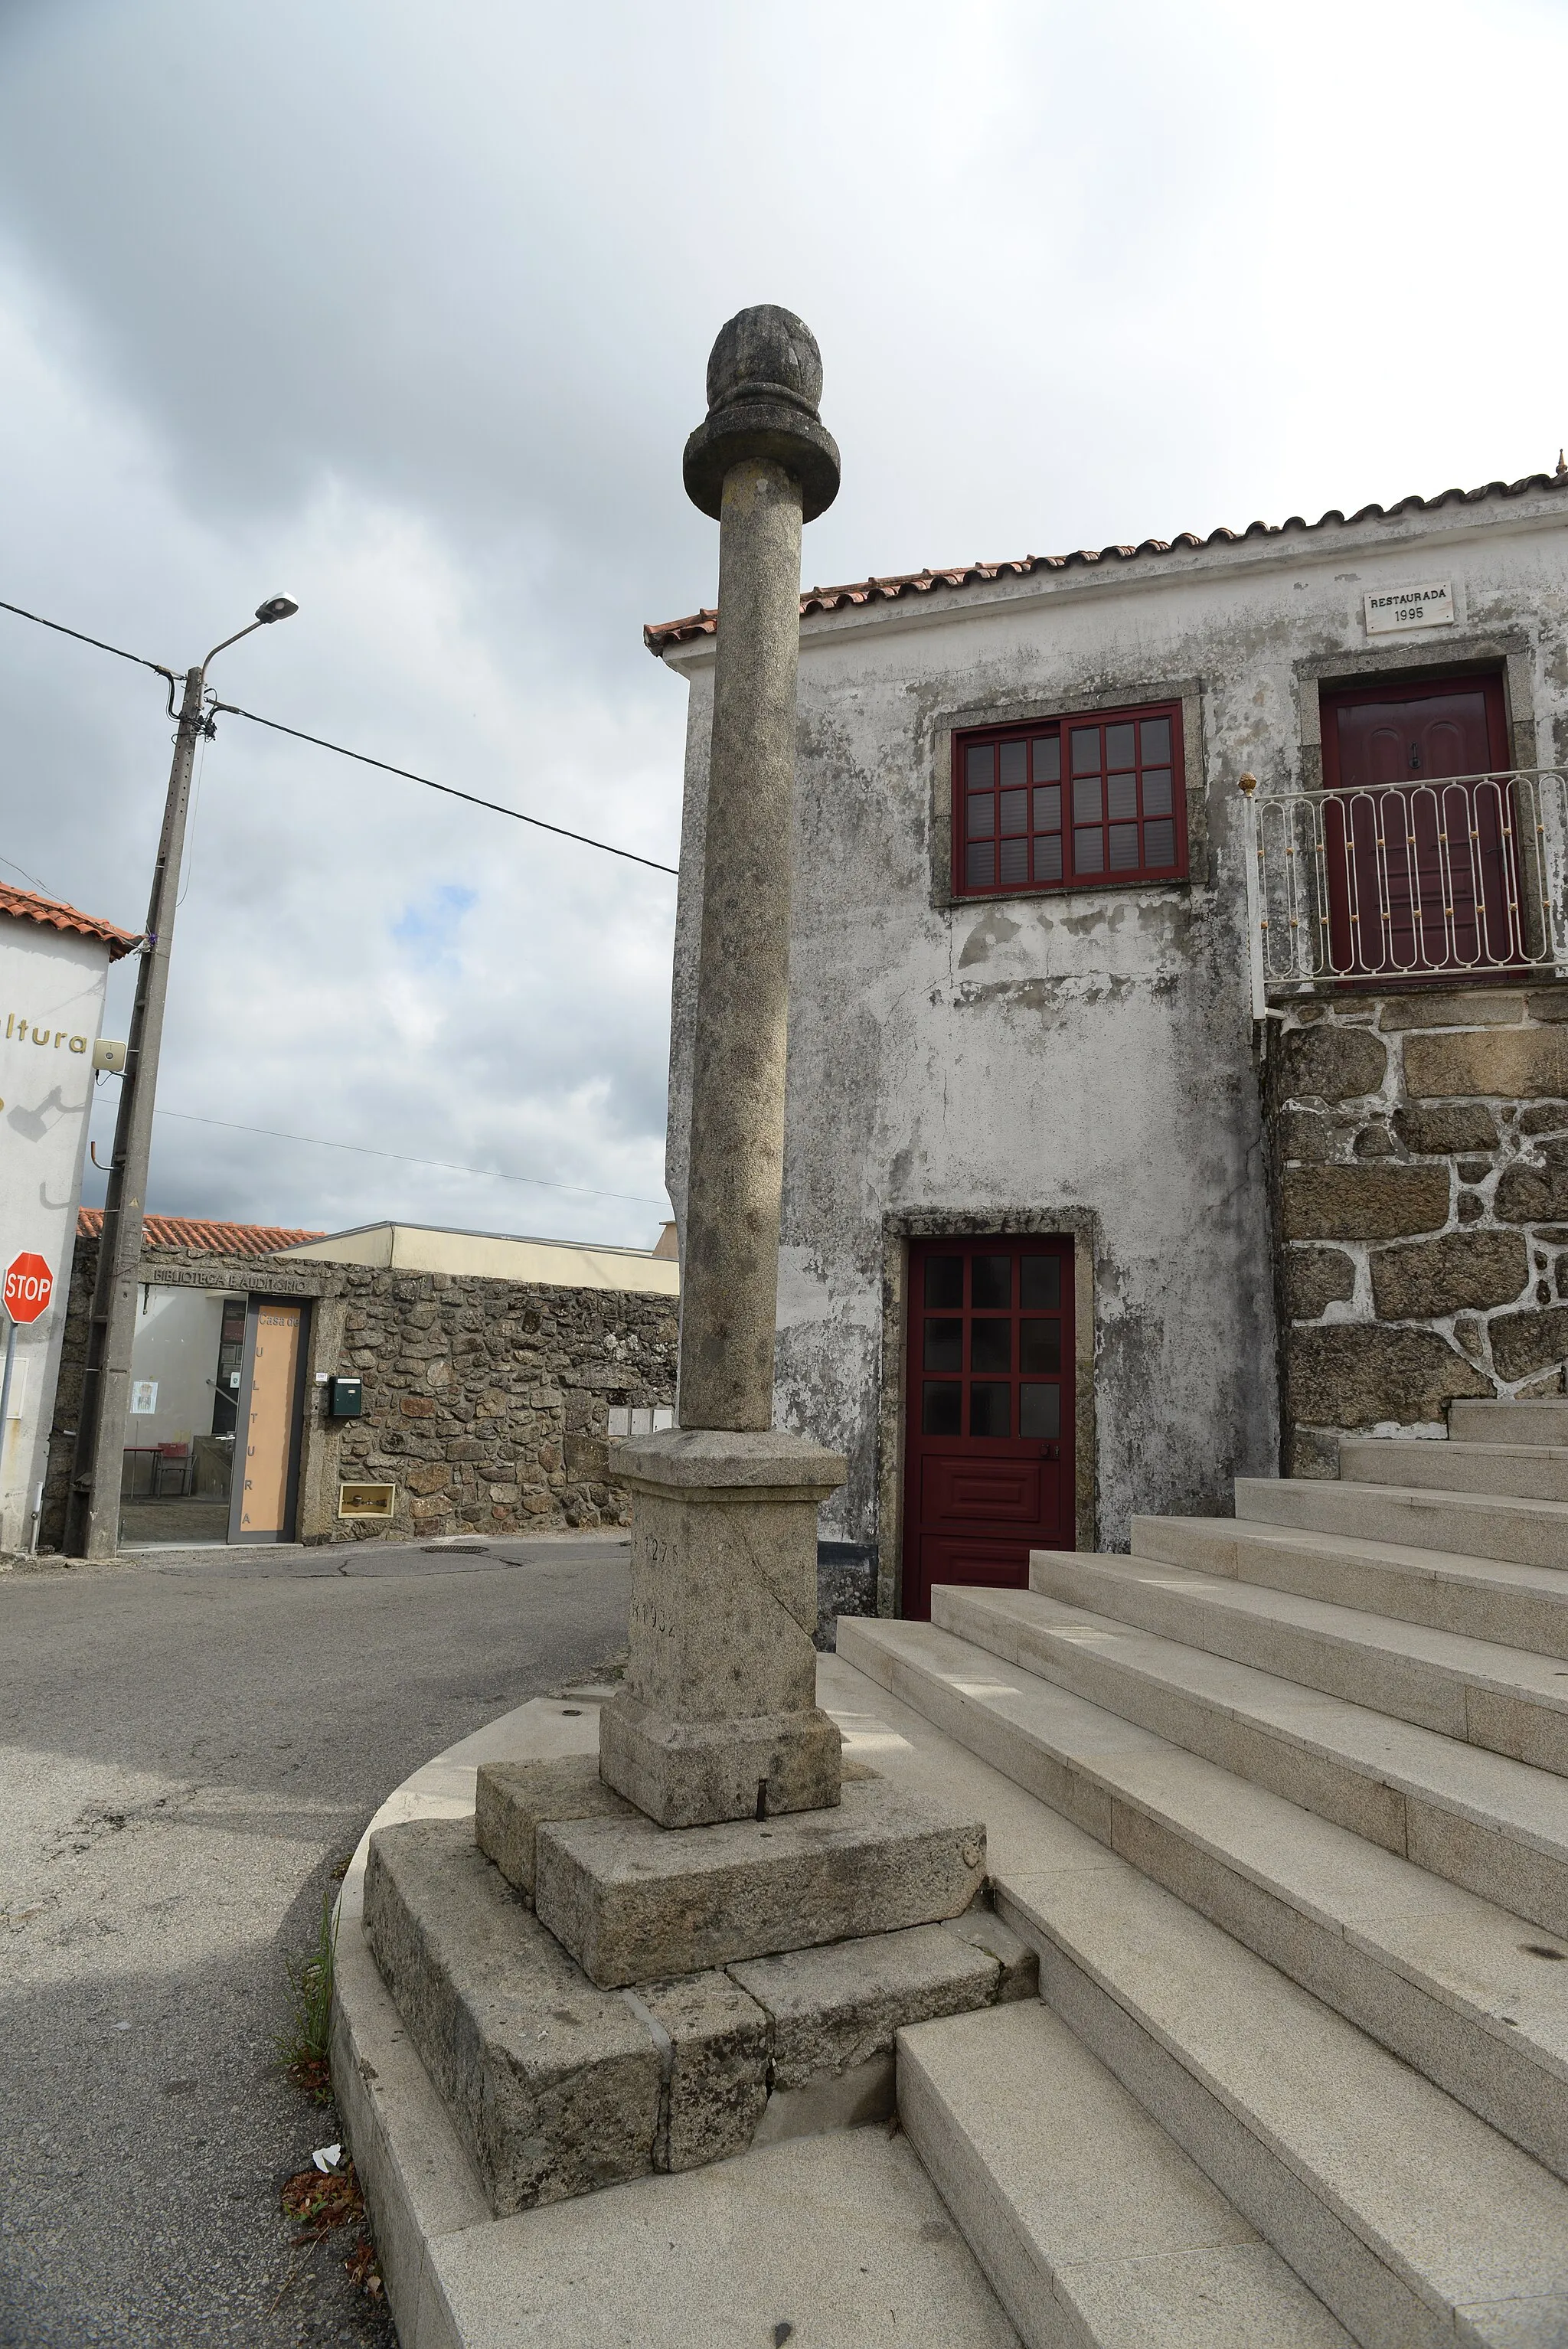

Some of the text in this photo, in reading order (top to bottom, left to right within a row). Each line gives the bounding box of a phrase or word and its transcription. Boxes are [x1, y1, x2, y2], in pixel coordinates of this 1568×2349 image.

[1370, 589, 1446, 609] RESTAURADA
[1394, 607, 1423, 622] 1995
[0, 1011, 87, 1054] ltura
[6, 1273, 51, 1301] STOP
[154, 1269, 224, 1286] BIBLIOTECA
[230, 1277, 236, 1287] E
[259, 1311, 284, 1326] Casa
[287, 1314, 299, 1327] de
